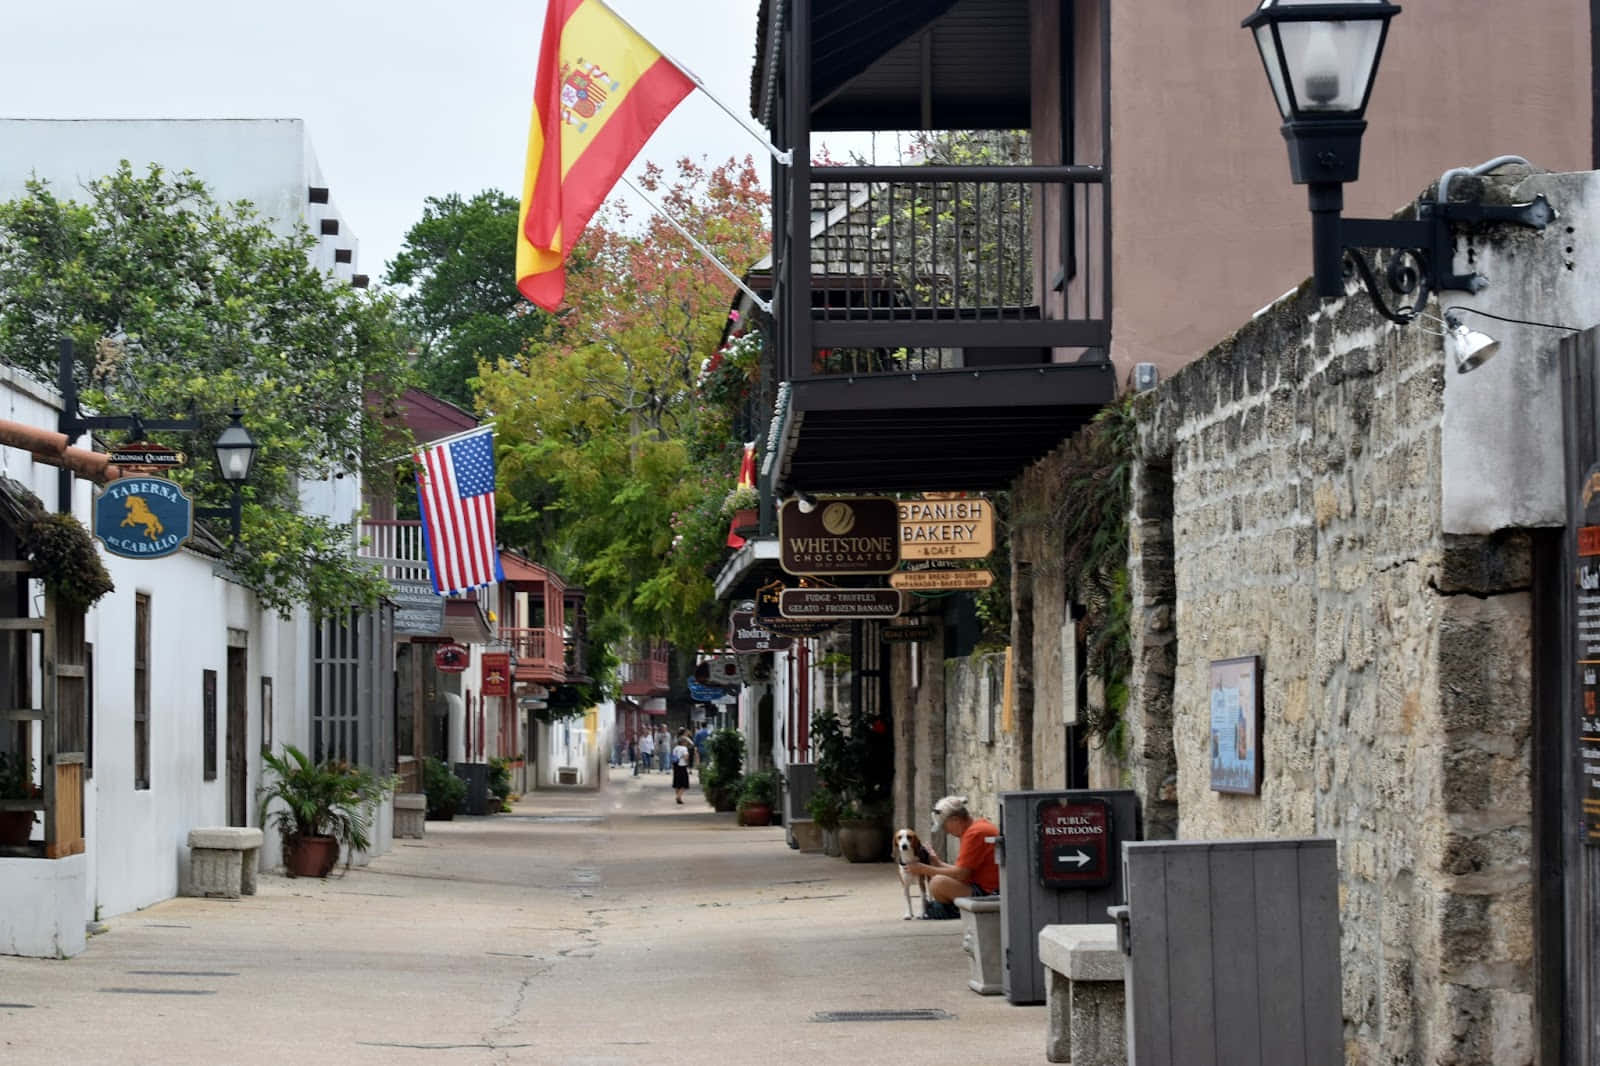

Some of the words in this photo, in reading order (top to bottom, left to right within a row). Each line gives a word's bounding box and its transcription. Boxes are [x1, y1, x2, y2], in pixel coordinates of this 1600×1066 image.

[110, 482, 178, 504] TABERNA
[898, 503, 982, 520] SPANISH
[900, 524, 977, 542] BAKERY
[121, 534, 178, 553] CABALLO
[790, 536, 893, 553] WHETSTONE
[930, 545, 956, 555] CAFÉ
[793, 553, 892, 562] CHOCOLATES
[805, 593, 831, 602] FUDGE
[838, 593, 876, 601] TRUFFLES
[788, 604, 819, 612] GELATO
[825, 604, 856, 612] FROZEN
[857, 604, 894, 612] BANANAS
[1056, 816, 1090, 825] PUBLIC
[1044, 825, 1104, 836] RESTROOMS
